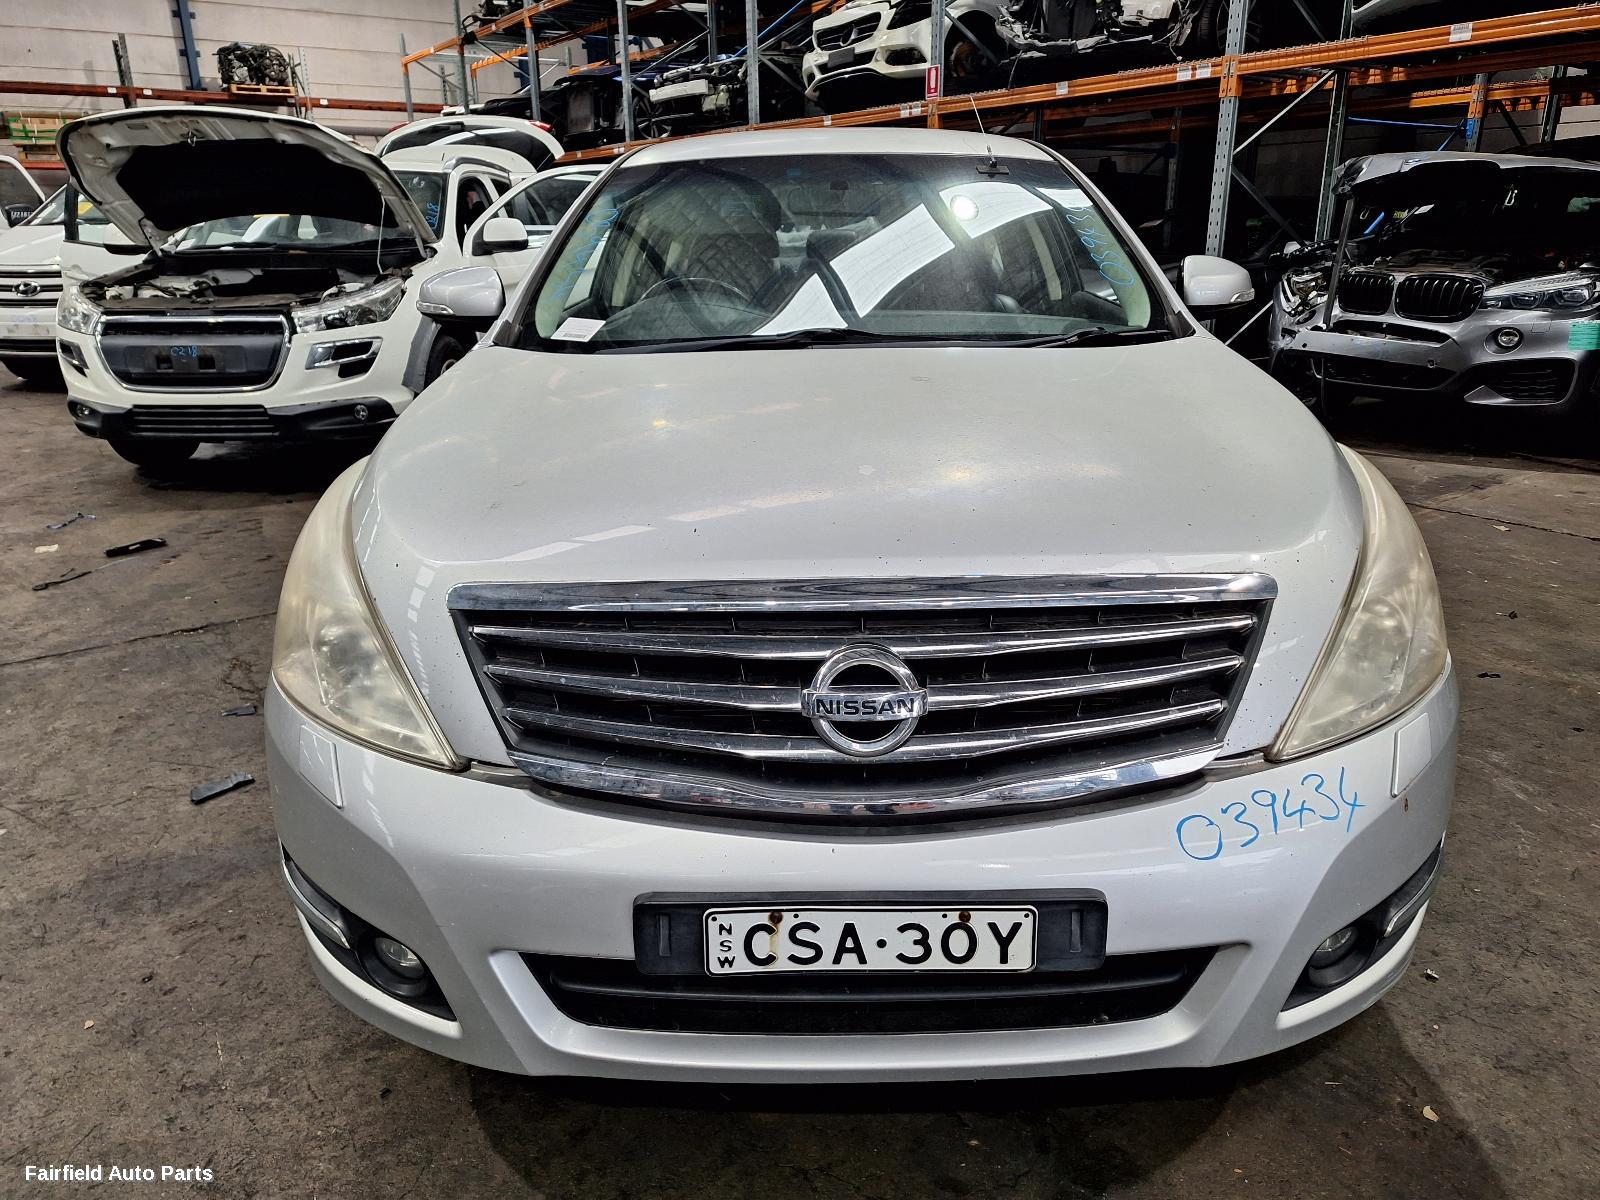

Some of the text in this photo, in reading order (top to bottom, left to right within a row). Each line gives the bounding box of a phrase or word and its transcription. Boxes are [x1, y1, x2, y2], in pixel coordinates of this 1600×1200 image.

[170, 345, 199, 358] C218
[815, 698, 915, 716] NISSAN
[1177, 767, 1366, 860] 039434
